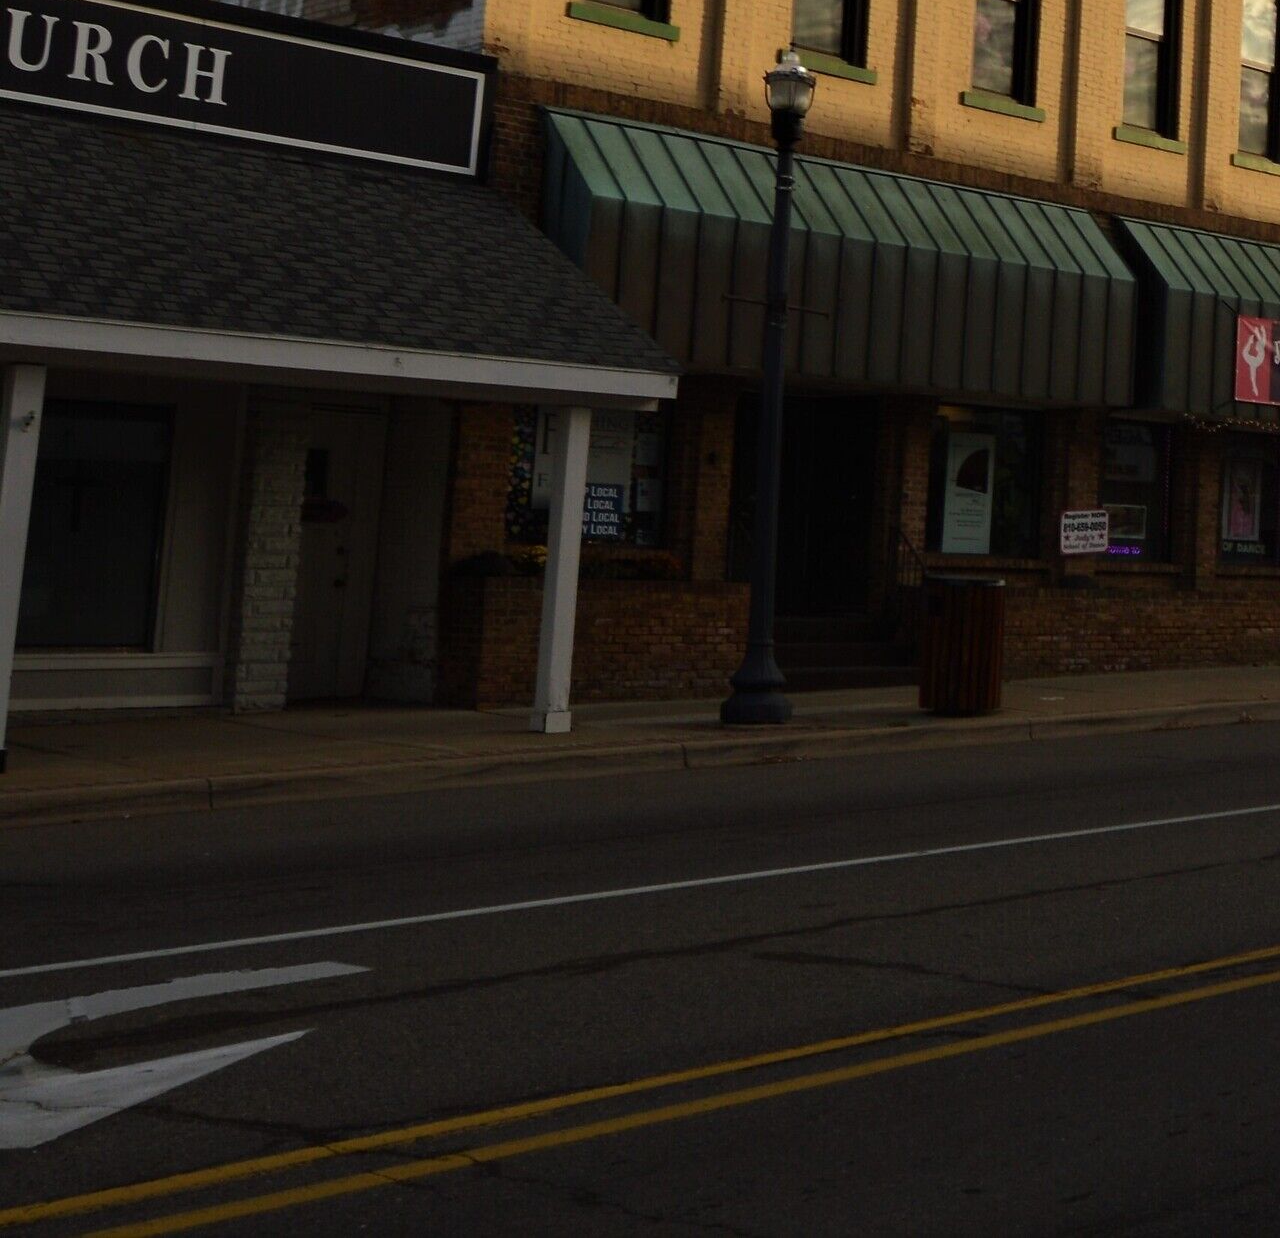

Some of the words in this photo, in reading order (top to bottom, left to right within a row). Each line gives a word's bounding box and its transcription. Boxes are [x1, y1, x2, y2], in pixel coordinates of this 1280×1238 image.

[592, 486, 619, 498] LOCAL
[587, 500, 616, 510] LOCAL
[593, 511, 620, 523] LOCAL
[591, 524, 618, 535] LOCAL
